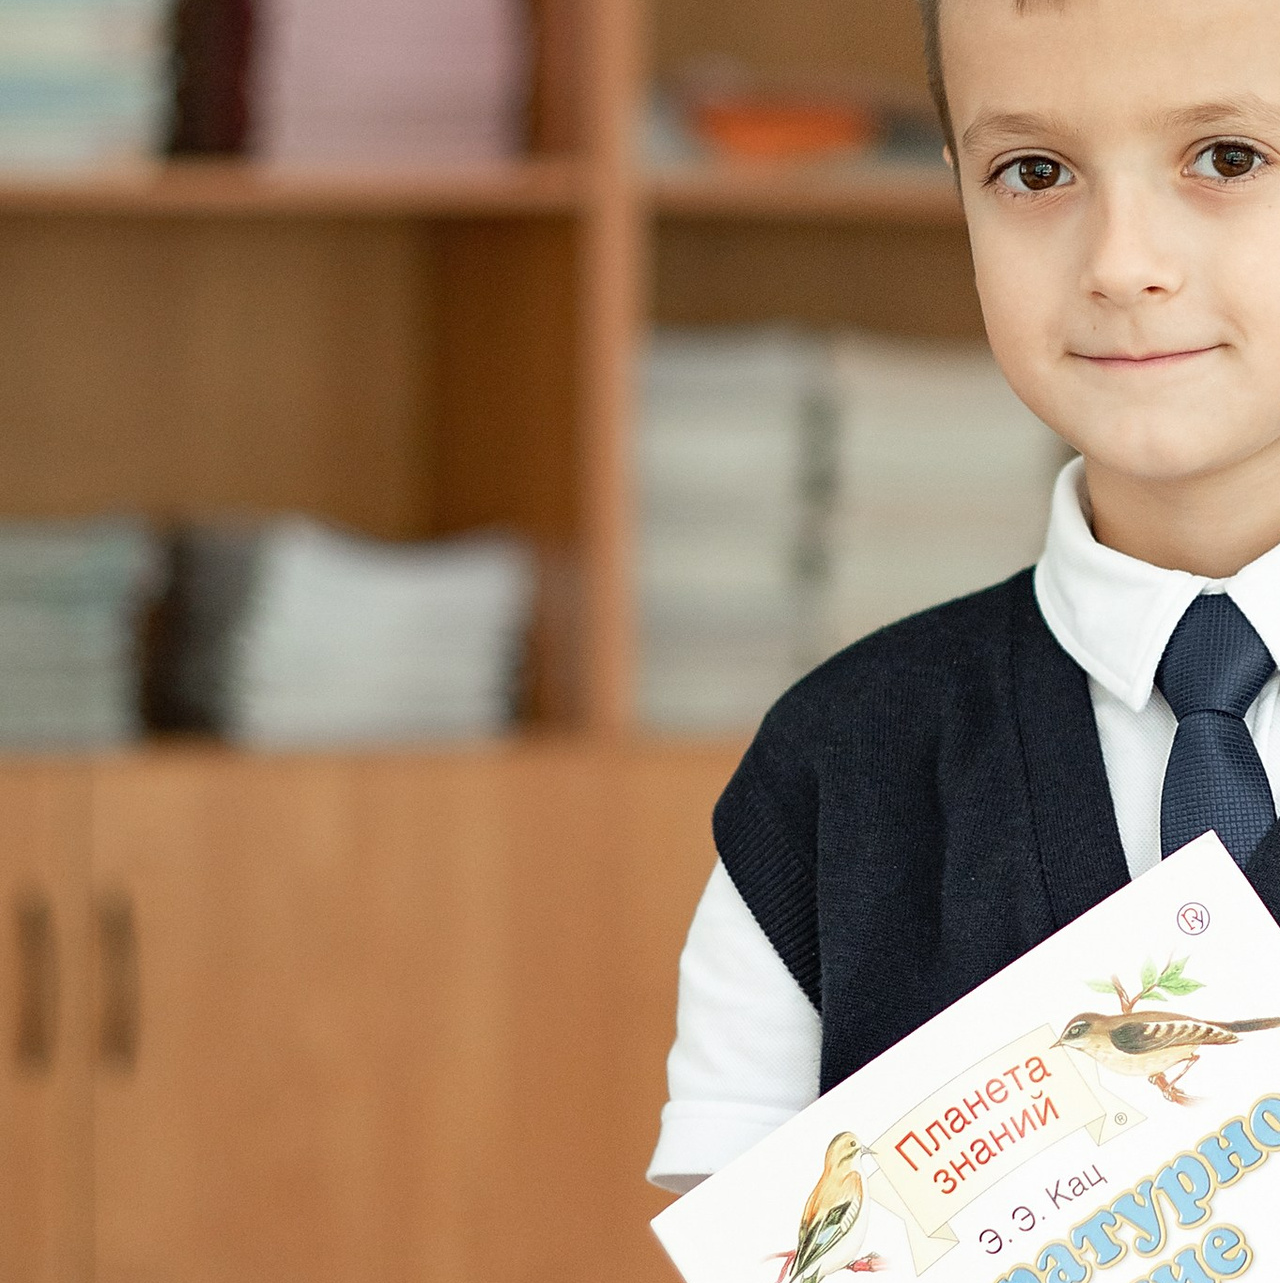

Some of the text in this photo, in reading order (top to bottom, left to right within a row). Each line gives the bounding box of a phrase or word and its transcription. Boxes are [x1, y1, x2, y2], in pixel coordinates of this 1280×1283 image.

[894, 1056, 1052, 1171] Планета
[933, 1090, 1060, 1194] знаний
[979, 1164, 1108, 1255] Э. Э. Кац
